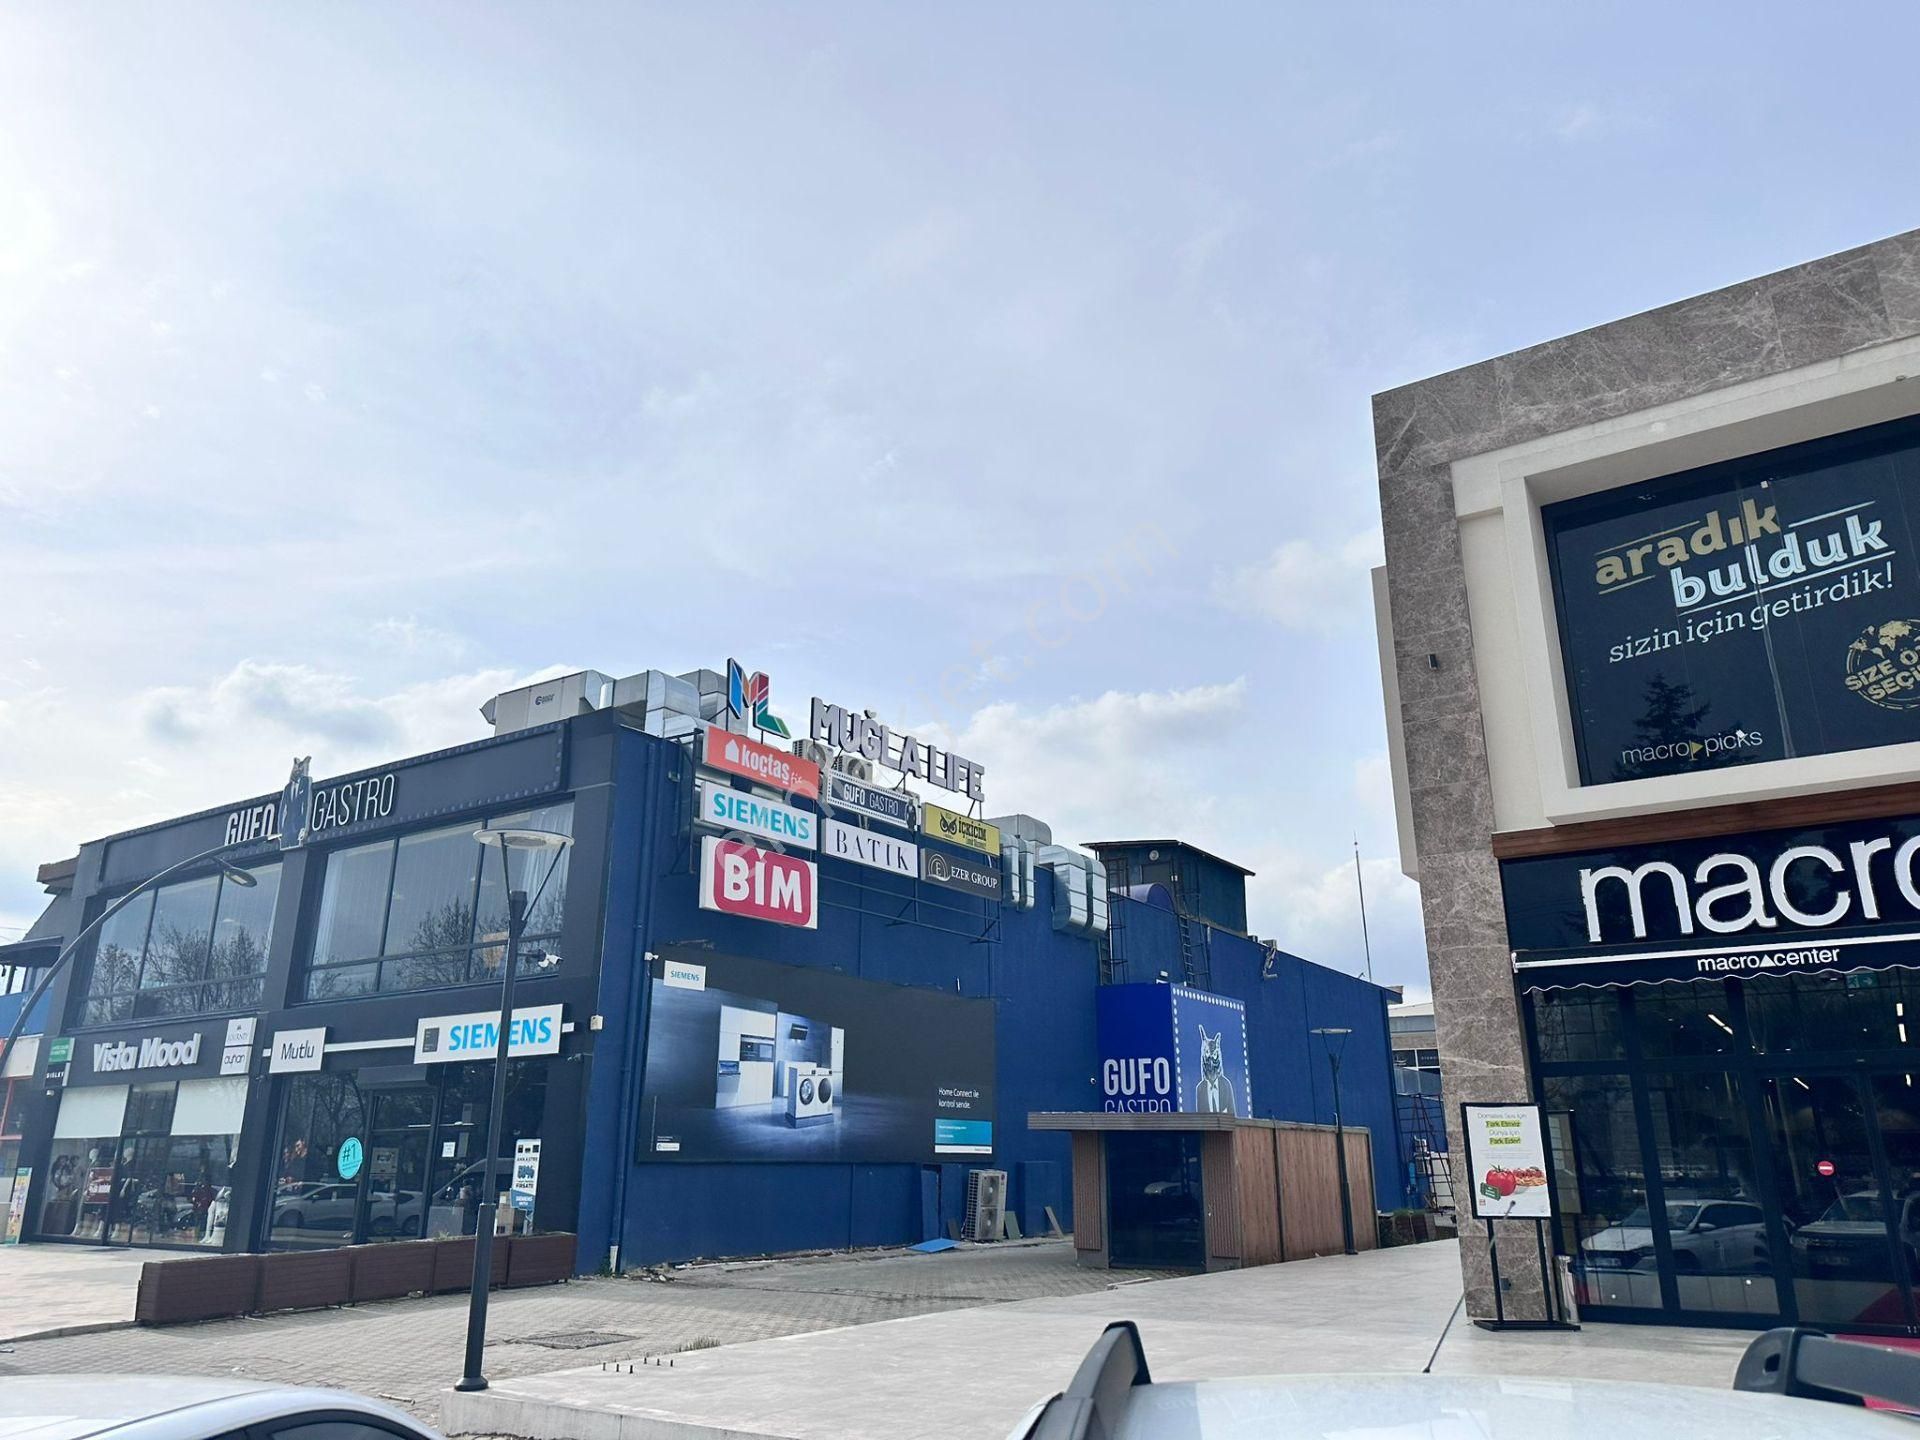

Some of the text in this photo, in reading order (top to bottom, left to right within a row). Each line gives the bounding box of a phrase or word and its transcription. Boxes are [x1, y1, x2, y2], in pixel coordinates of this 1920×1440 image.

[1595, 498, 1781, 586] aradık
[1670, 514, 1889, 608] bulduk
[1608, 560, 1894, 664] sizin için getirdik!
[1844, 659, 1898, 691] SİZE
[741, 743, 790, 785] koçtaş
[811, 696, 985, 802] MUĞLA LIFE
[1621, 730, 1763, 764] macro picks
[224, 773, 395, 846] GUFO GASTRO
[713, 792, 809, 840] SIEMENS
[843, 783, 899, 816] GUFO GASTRO
[836, 829, 909, 871] BATİK
[723, 853, 803, 914] BİM
[951, 866, 998, 889] EZER GROUP
[670, 970, 700, 982] SIEMENS
[1697, 947, 1840, 971] macro center
[93, 1033, 201, 1072] Vista Mood
[280, 1043, 314, 1061] Mutlu
[448, 1016, 552, 1051] SIEMENS
[1103, 1056, 1170, 1096] GUFO
